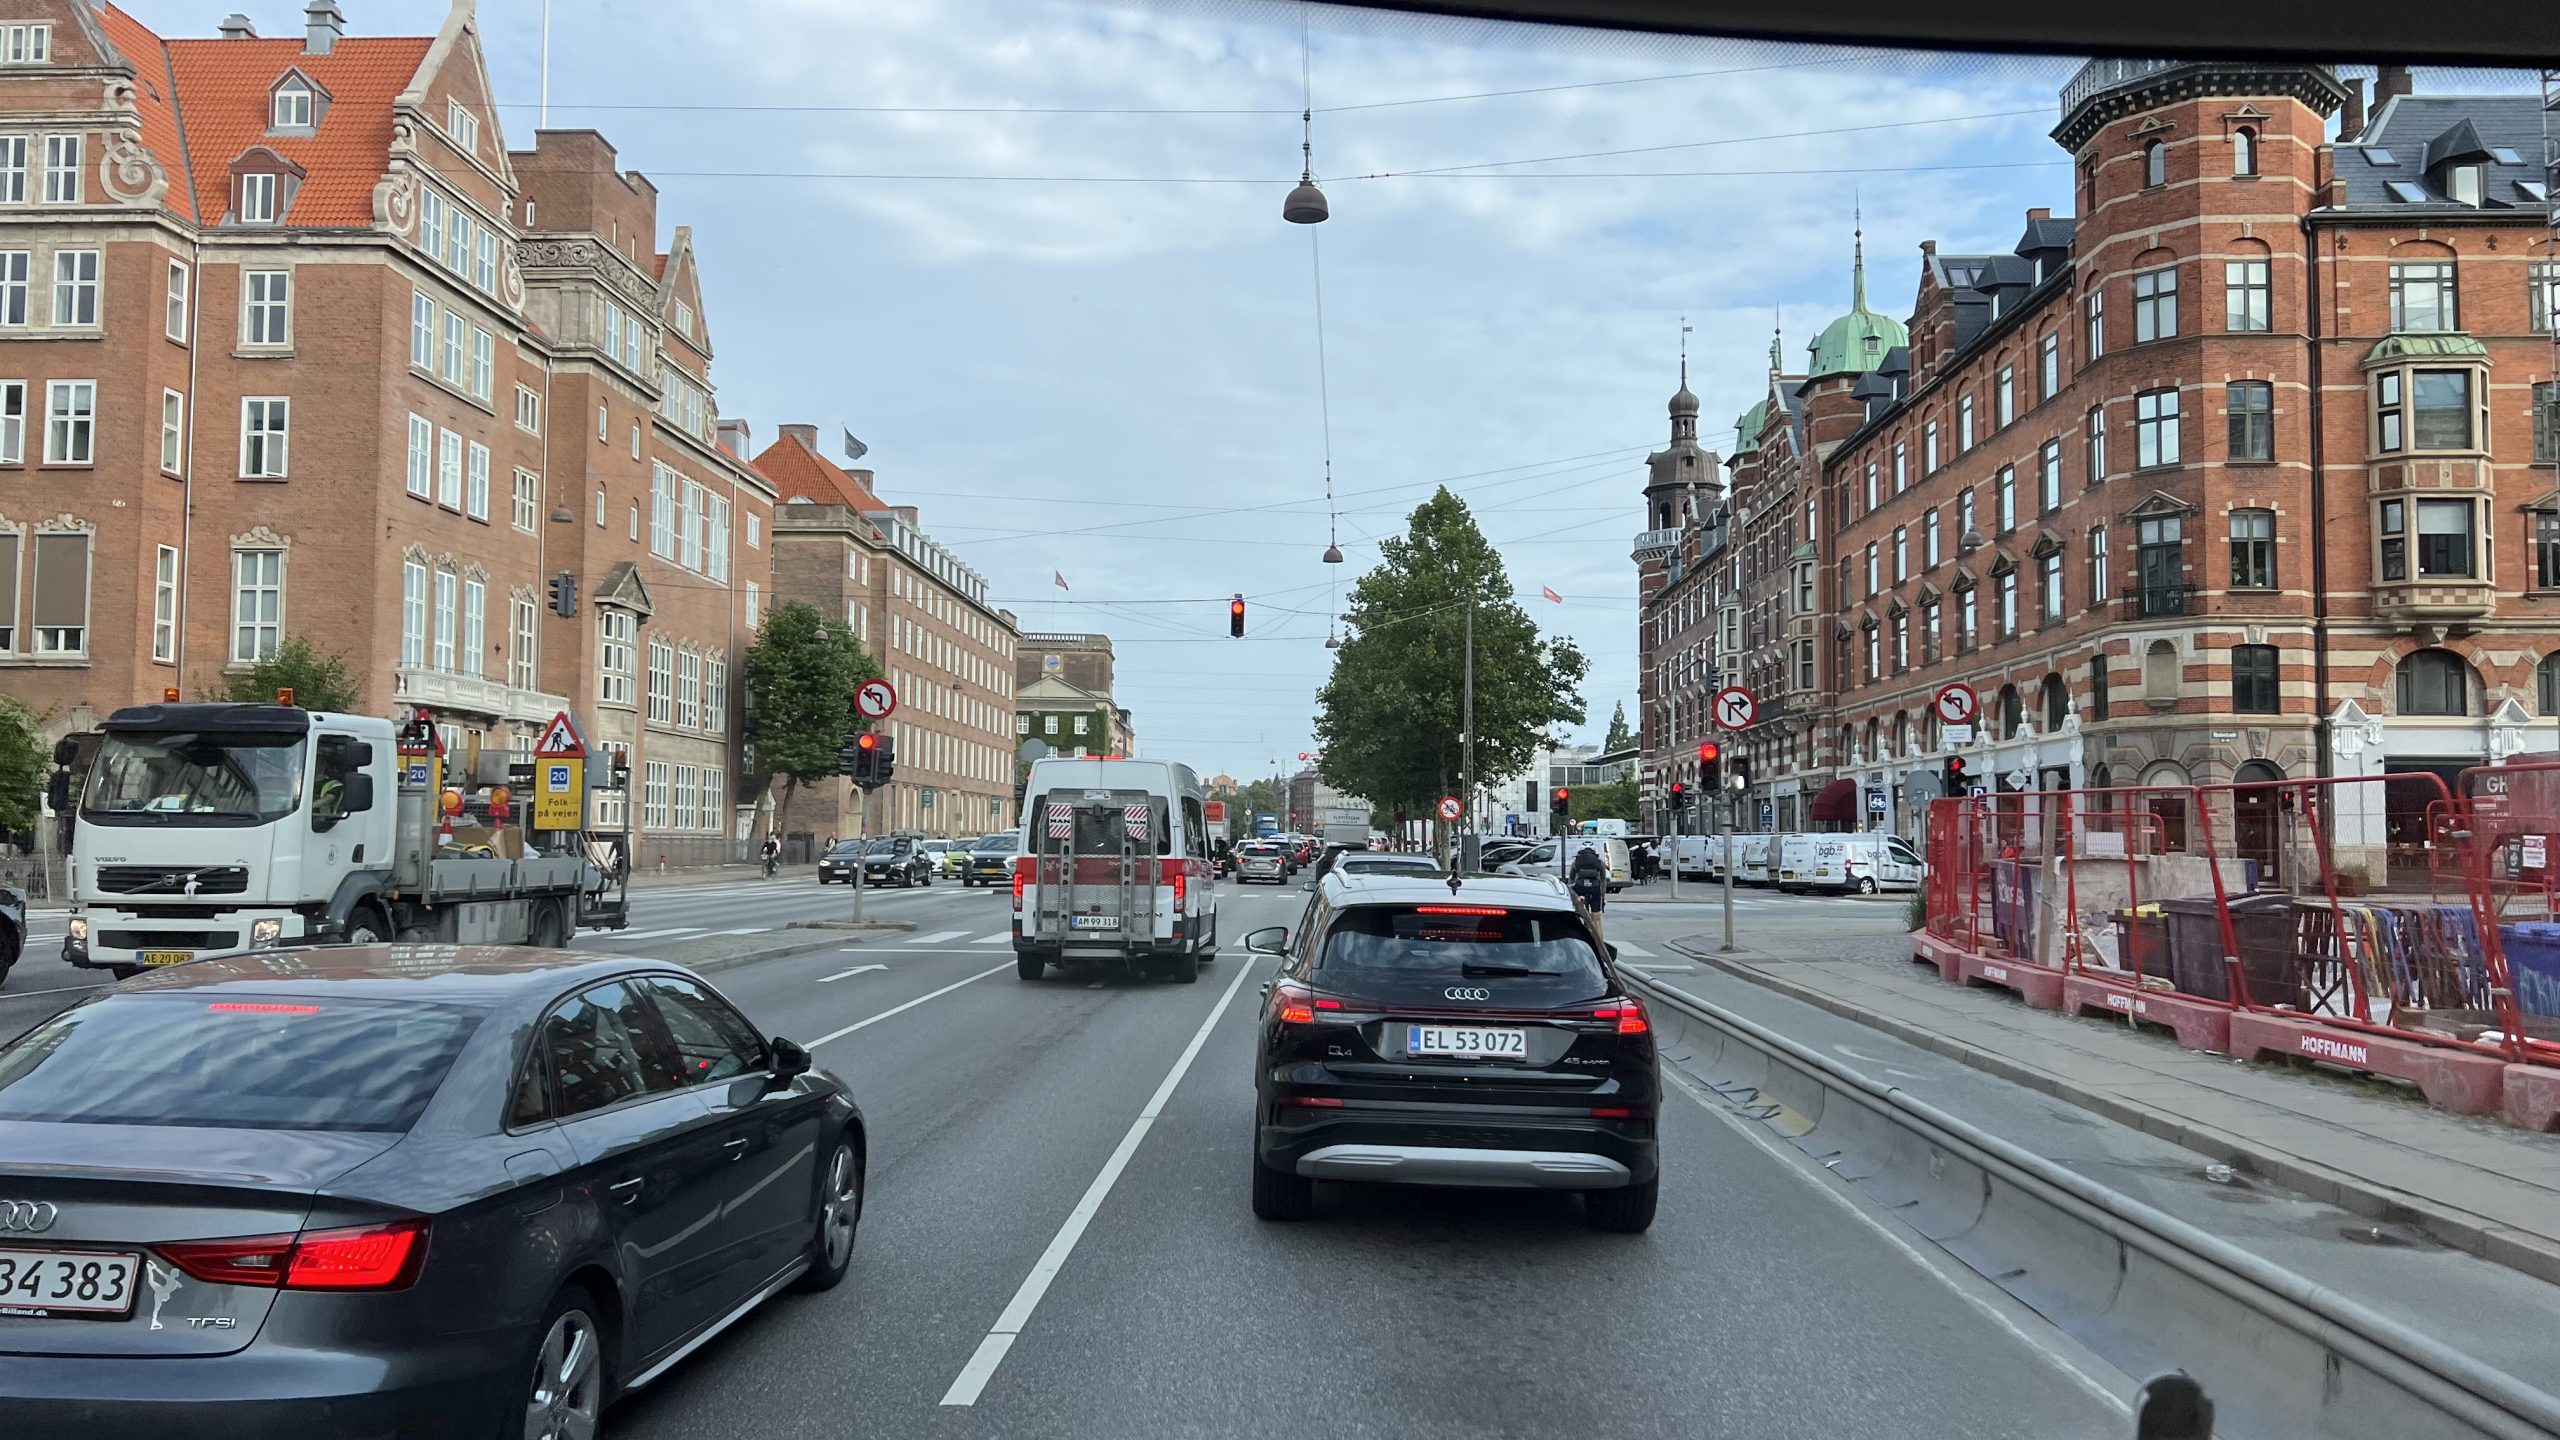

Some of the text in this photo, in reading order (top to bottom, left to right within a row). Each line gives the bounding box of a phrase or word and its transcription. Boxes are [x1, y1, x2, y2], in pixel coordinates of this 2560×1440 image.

[411, 769, 426, 779] 20
[551, 771, 567, 781] 20
[548, 798, 568, 806] Folk
[538, 808, 578, 818] på vejen
[1763, 805, 1770, 814] P
[1818, 845, 1836, 858] bgb
[1103, 918, 1118, 926] 318
[144, 953, 157, 963] AE
[160, 954, 171, 963] 20
[2107, 993, 2146, 1013] HOFFMANN
[1424, 1031, 1523, 1052] EL 53 072
[2301, 1035, 2367, 1064] HOFFMANN
[51, 1260, 126, 1302] 383
[187, 1317, 237, 1330] TFSI
